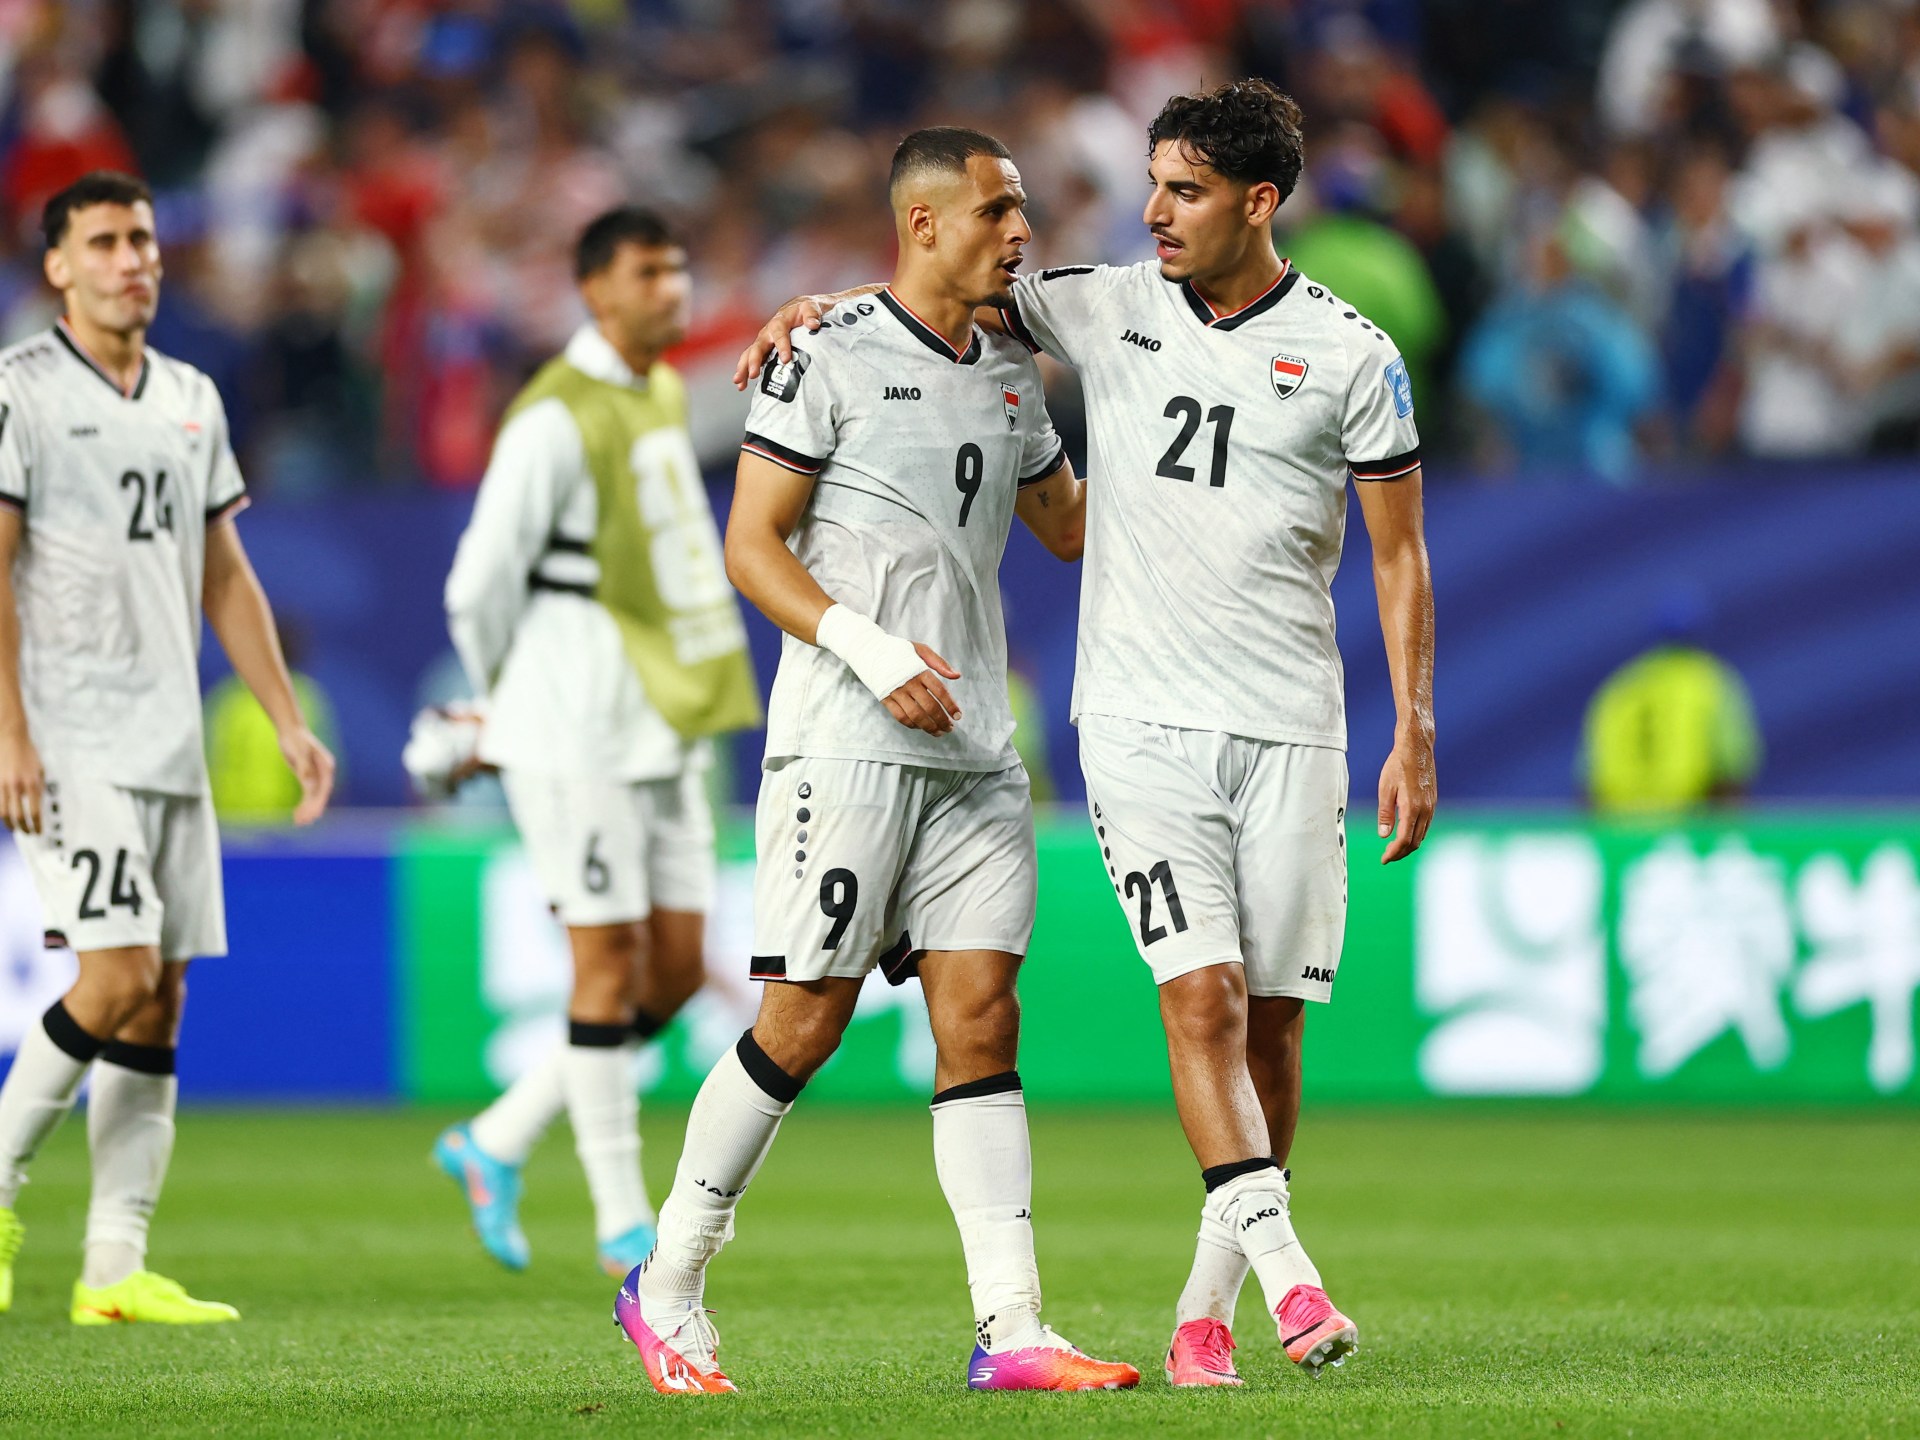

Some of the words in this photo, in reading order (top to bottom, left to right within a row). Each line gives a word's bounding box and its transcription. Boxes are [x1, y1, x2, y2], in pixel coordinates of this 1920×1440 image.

[1120, 329, 1162, 352] JAKO
[883, 386, 922, 401] JAKO
[1155, 395, 1236, 488] 21
[955, 442, 984, 528] 9
[71, 848, 142, 920] 24
[584, 833, 612, 894] 6
[819, 867, 859, 950] 9
[1124, 859, 1189, 948] 21
[1241, 1207, 1279, 1232] JAKO
